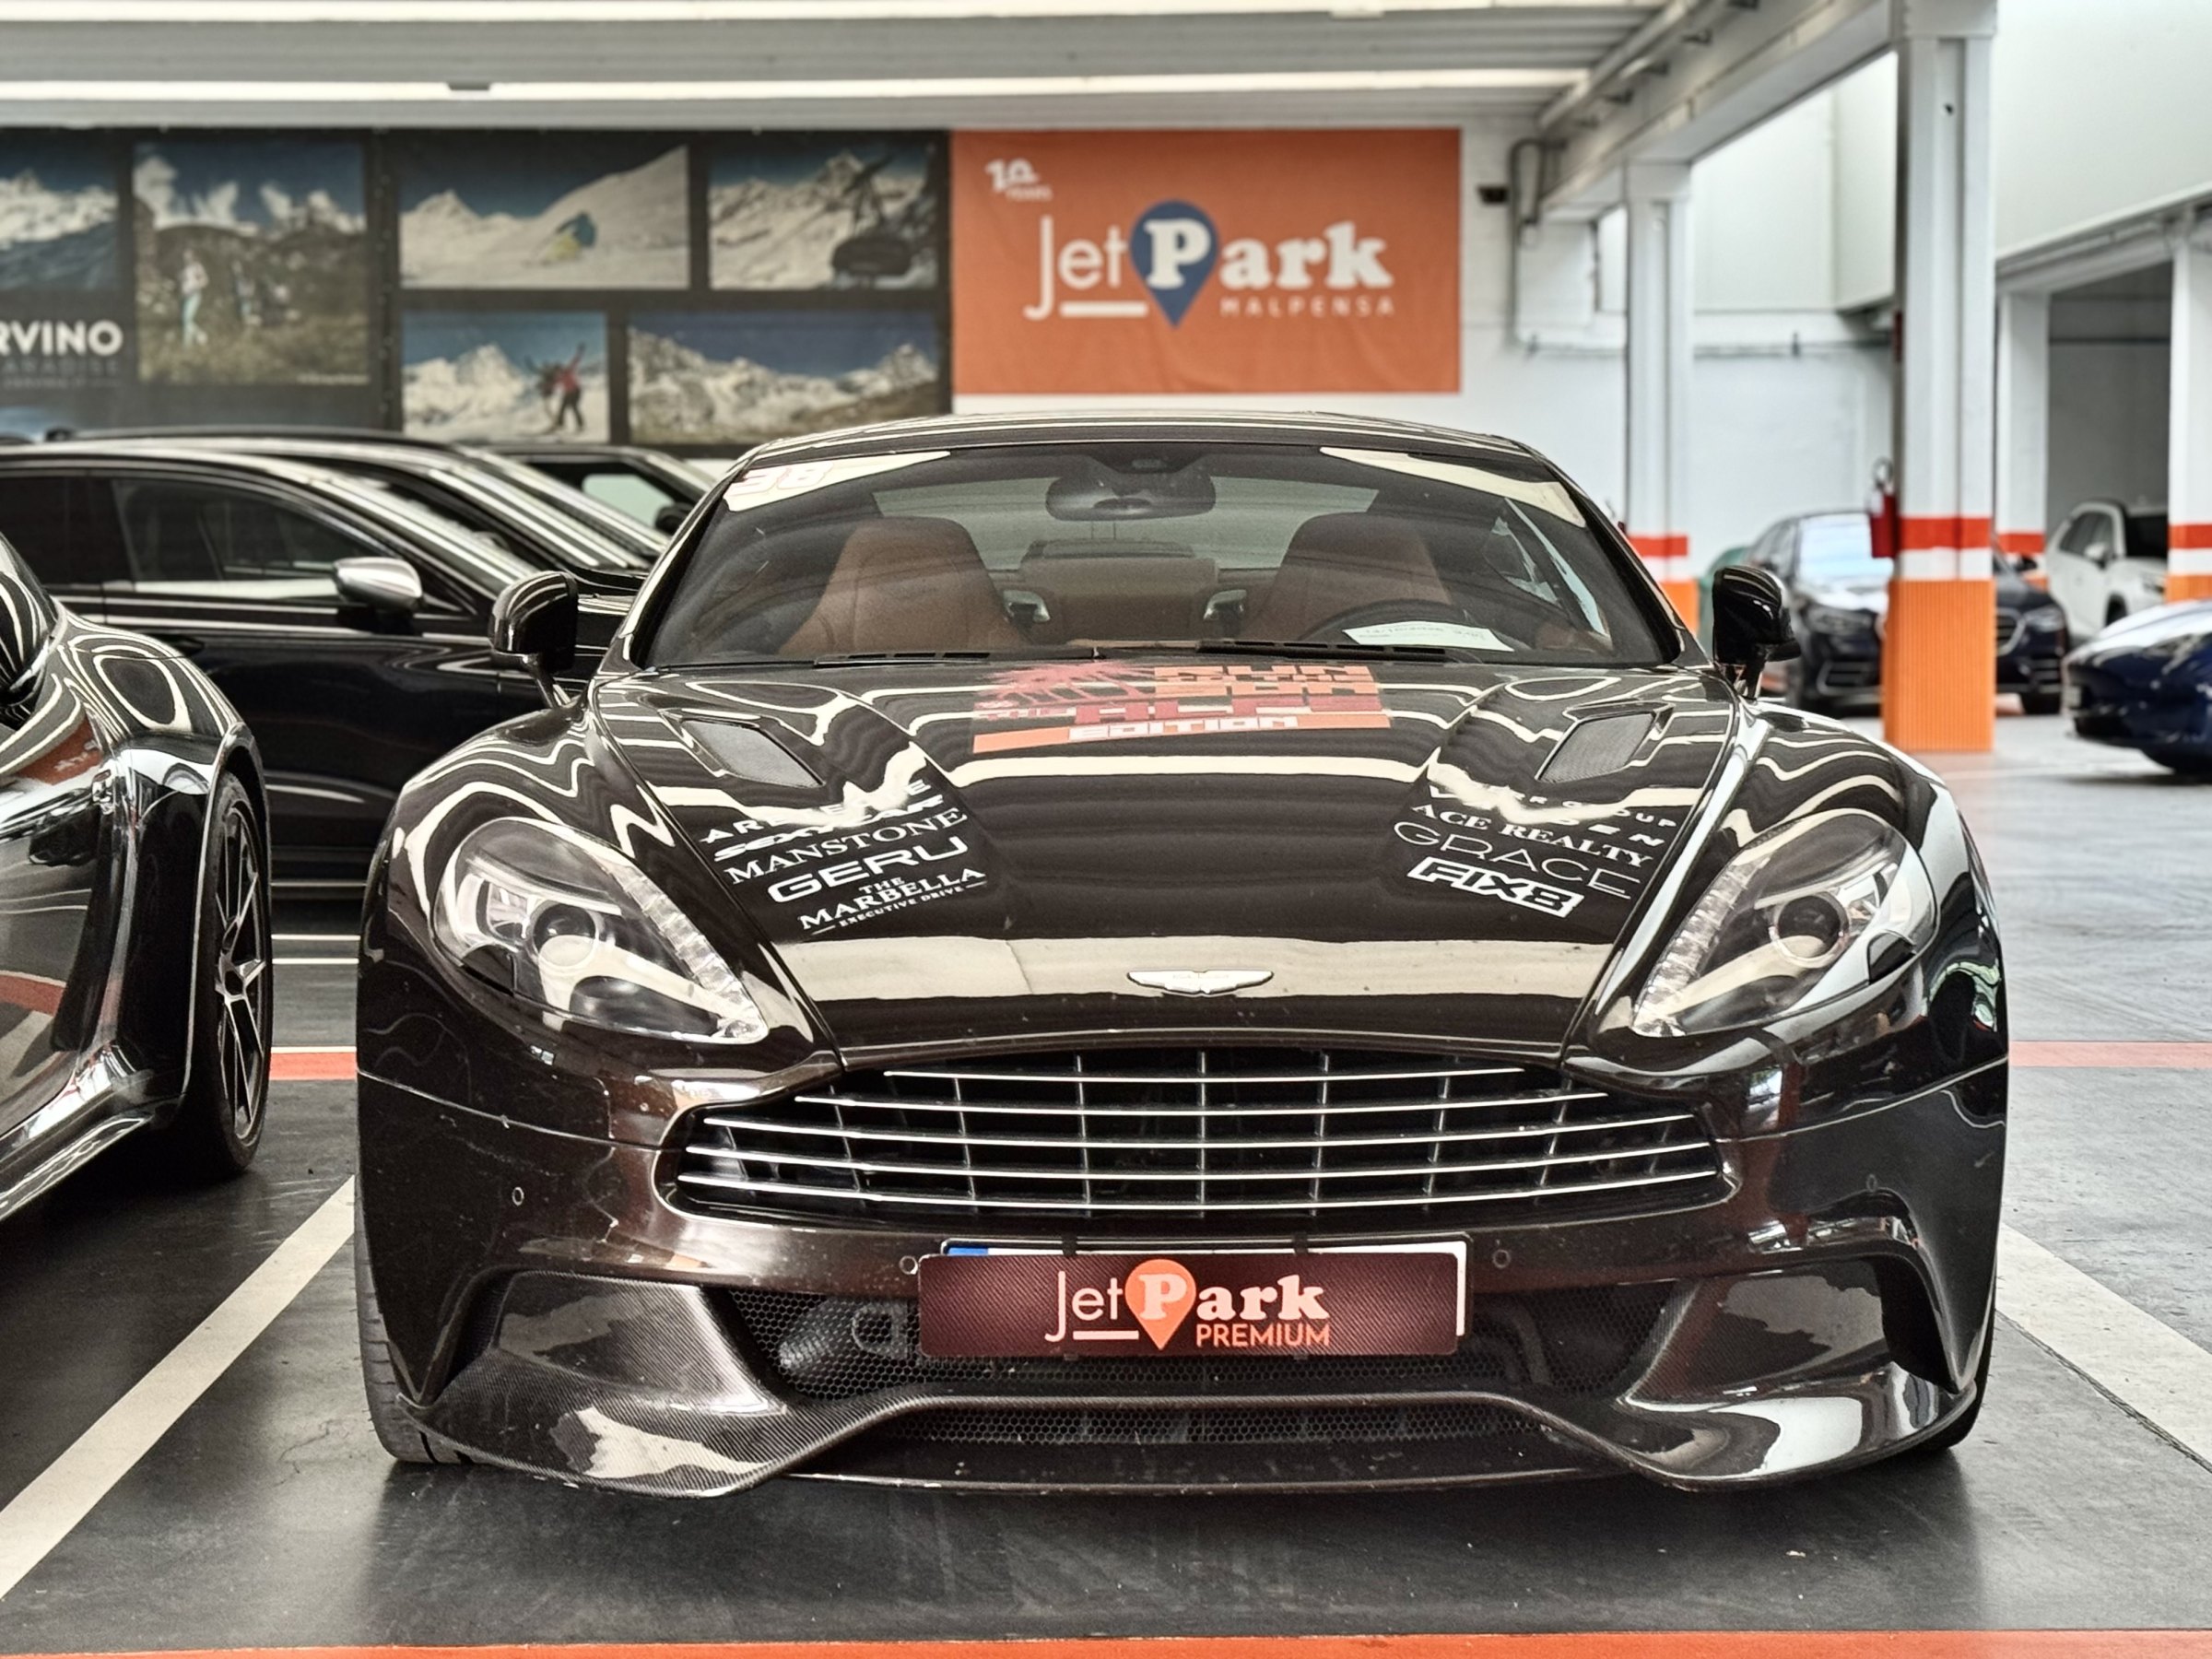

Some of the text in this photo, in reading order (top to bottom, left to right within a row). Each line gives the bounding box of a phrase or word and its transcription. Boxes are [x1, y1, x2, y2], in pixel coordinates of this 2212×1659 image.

[1219, 297, 1394, 317] MALPENSA
[1069, 716, 1299, 742] EDITION
[1410, 804, 1654, 868] ACE REALTY
[1562, 800, 1677, 828] GOUP
[724, 807, 968, 885] MANSTONE
[767, 835, 969, 903] GERU
[1394, 821, 1641, 900] GRACE
[797, 867, 986, 930] MARBELLA
[839, 886, 965, 927] EXECUTIVE DRIVE
[858, 877, 906, 895] THE
[1409, 857, 1583, 917] FIX8
[1195, 1324, 1331, 1347] PREMIUM
